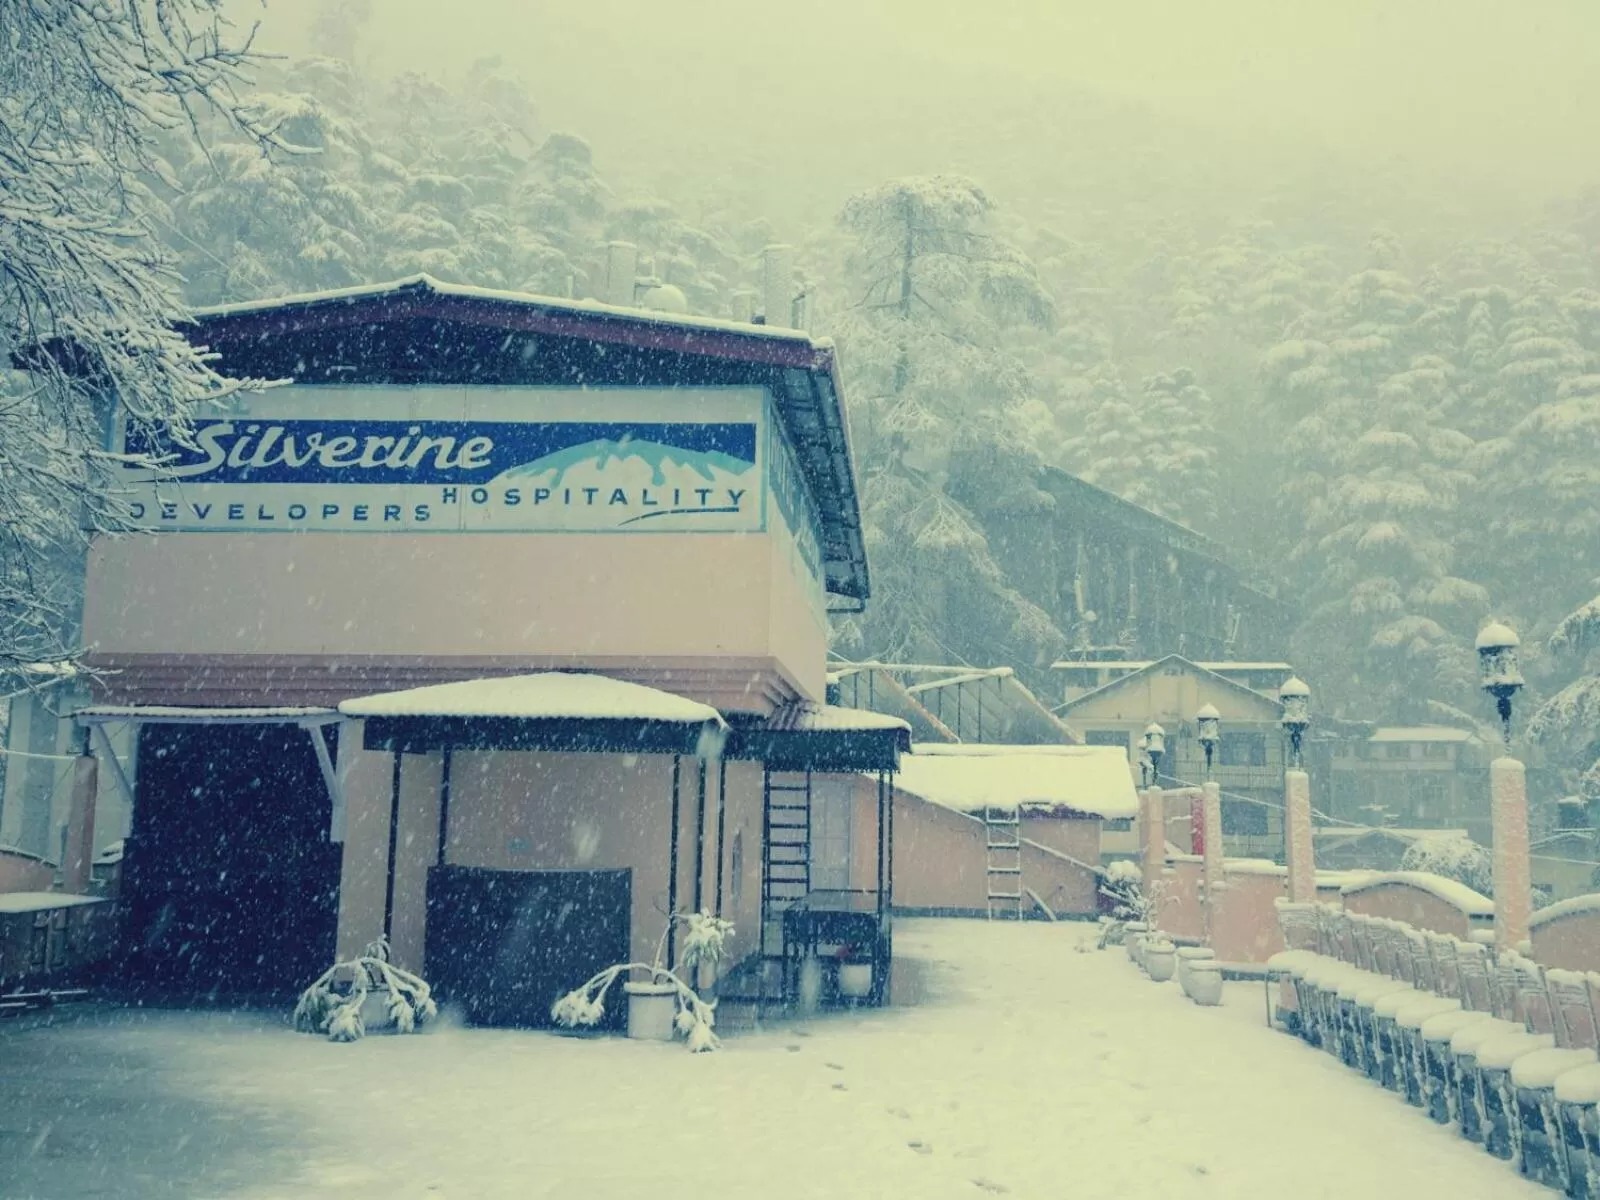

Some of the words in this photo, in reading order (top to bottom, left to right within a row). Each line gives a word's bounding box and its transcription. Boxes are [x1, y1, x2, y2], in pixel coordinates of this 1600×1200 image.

[170, 423, 494, 478] Silverine
[442, 487, 747, 506] HOSPITALITY
[130, 503, 432, 521] DEVELOPERS
